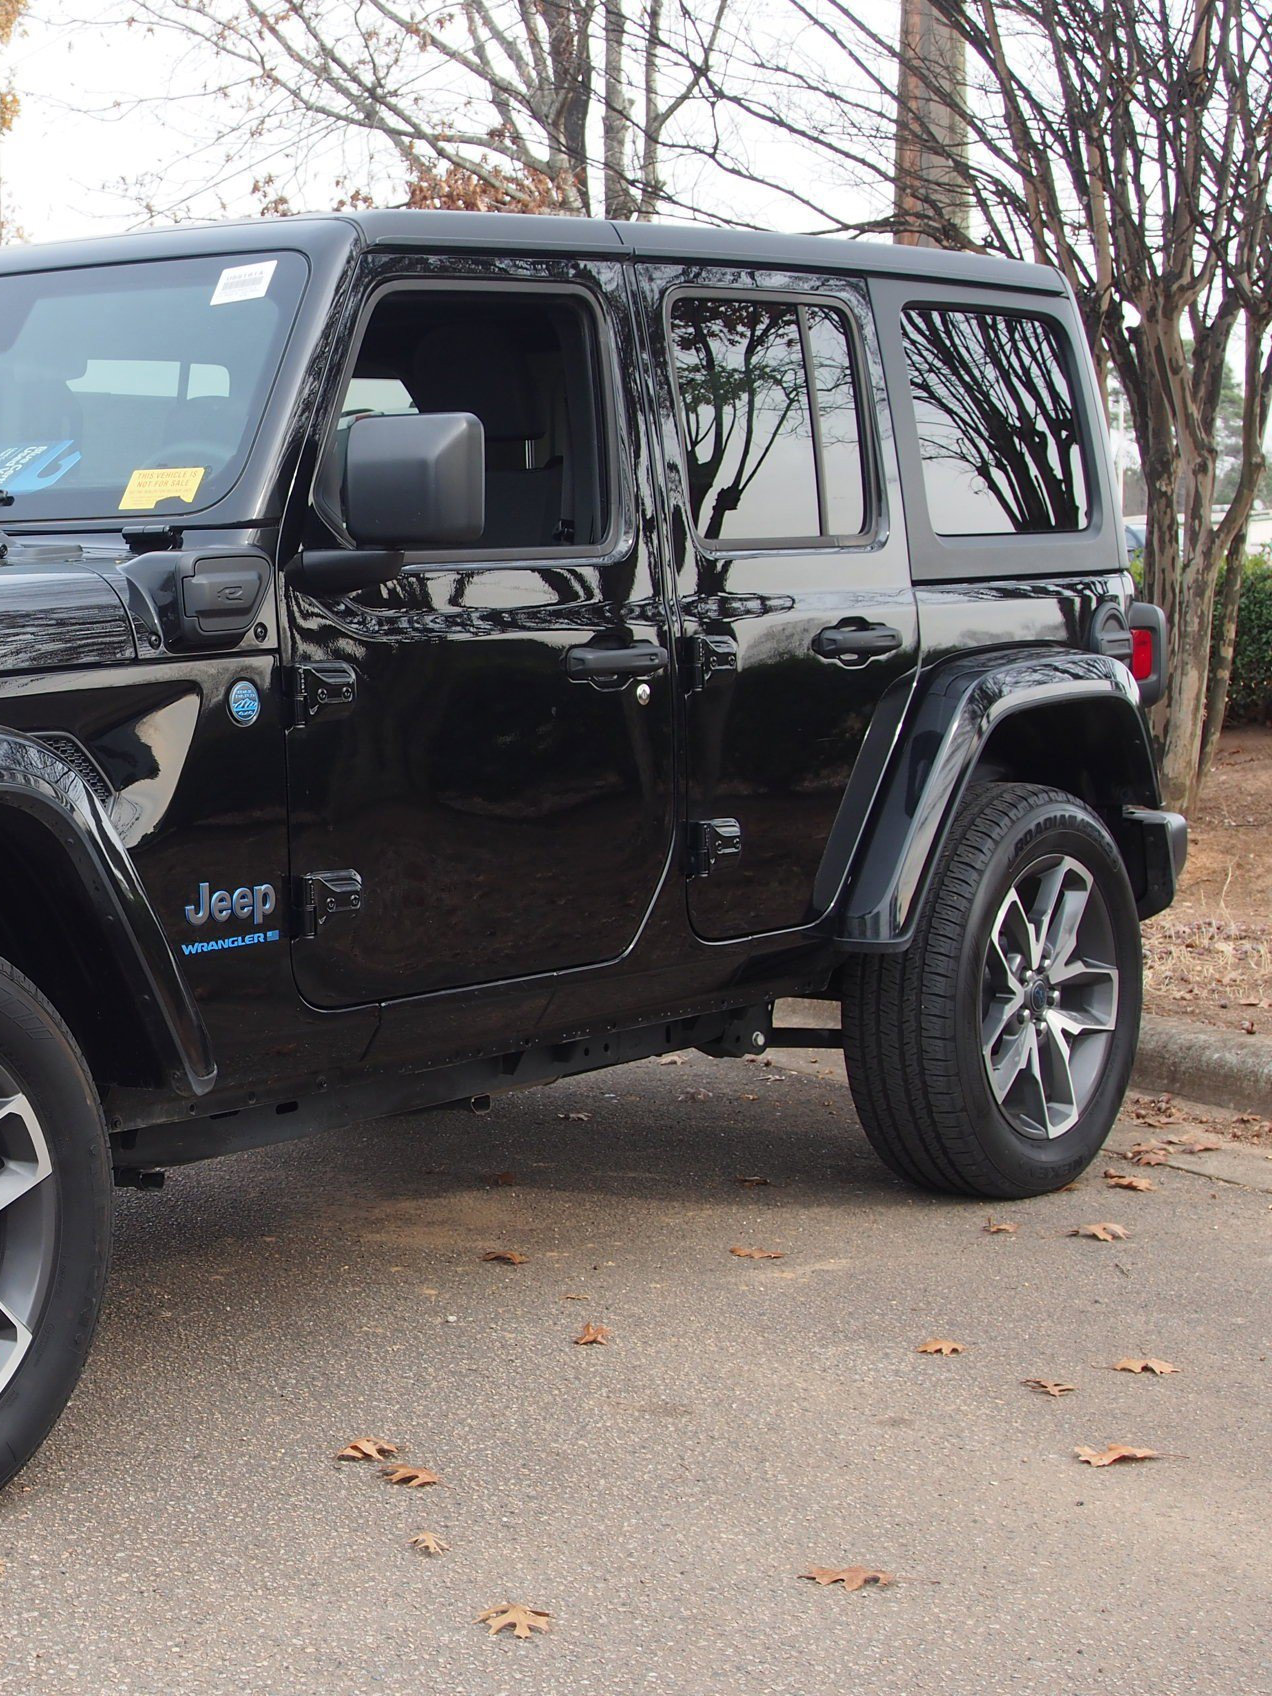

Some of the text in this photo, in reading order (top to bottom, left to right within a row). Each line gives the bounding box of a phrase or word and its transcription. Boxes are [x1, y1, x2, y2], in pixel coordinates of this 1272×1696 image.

[156, 470, 188, 479] VEHICLE
[189, 470, 198, 478] IS
[136, 479, 190, 488] NOT FOR SALE
[185, 882, 276, 926] Jeep
[181, 932, 265, 956] WRANGLER
